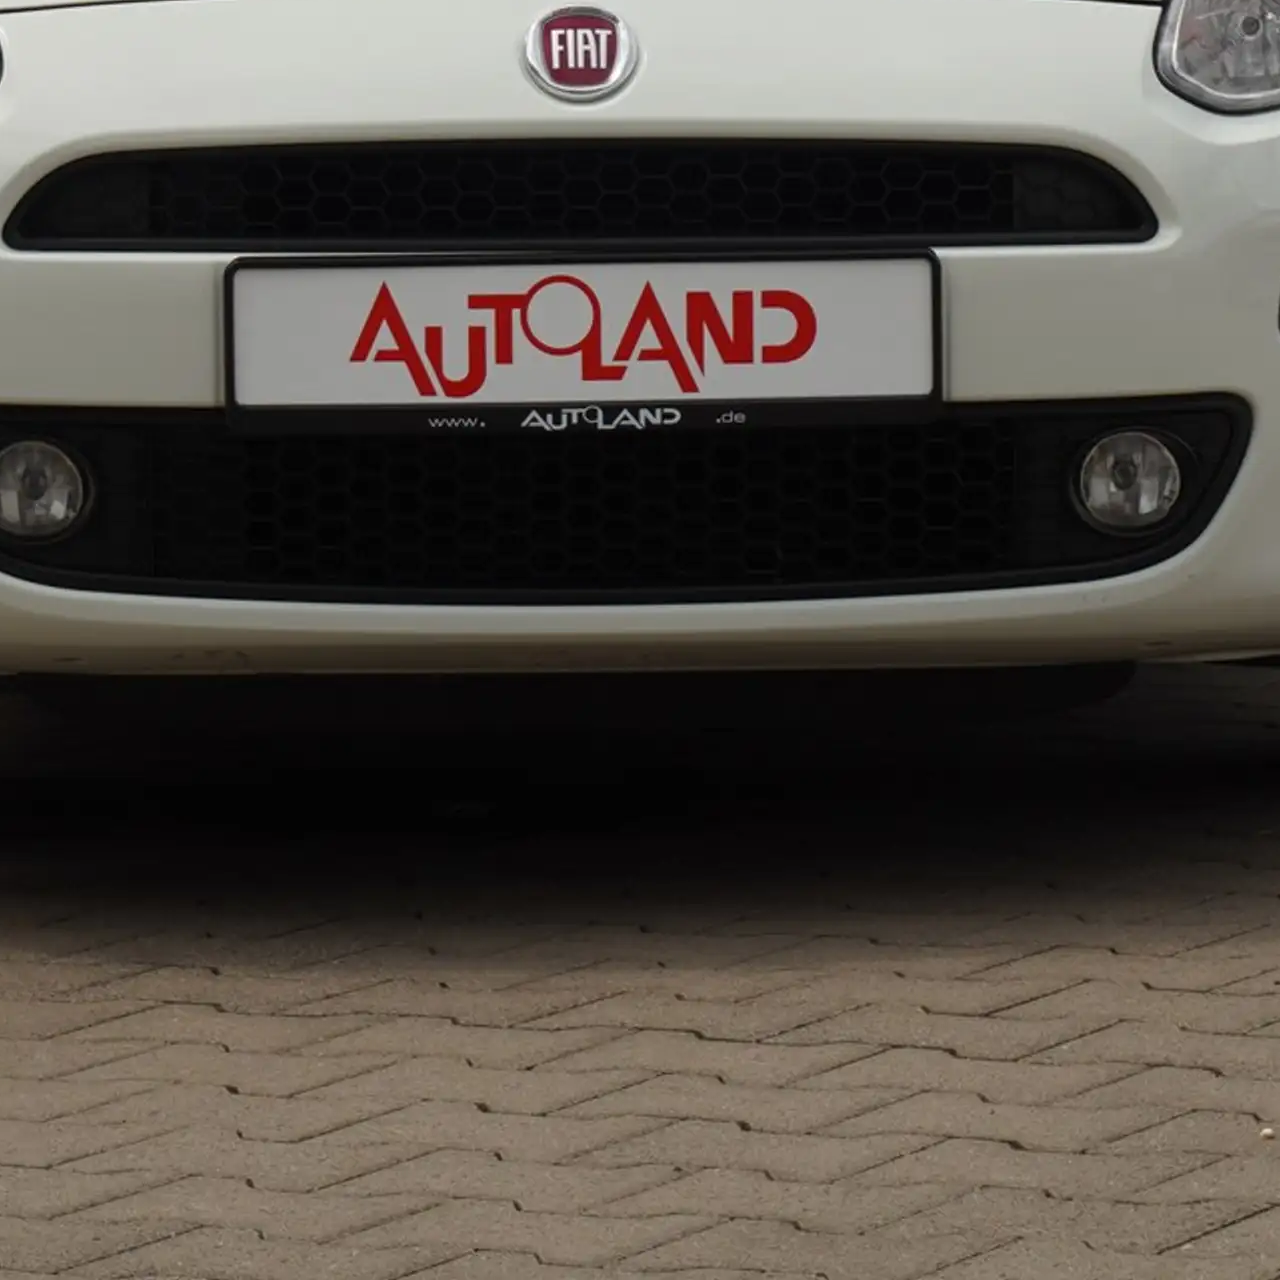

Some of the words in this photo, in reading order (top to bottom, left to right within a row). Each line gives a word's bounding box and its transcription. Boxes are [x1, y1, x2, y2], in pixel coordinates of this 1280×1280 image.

[550, 28, 612, 70] FIAT
[350, 274, 818, 398] AUTOLAND
[428, 415, 486, 429] www.
[521, 404, 682, 431] AUTOLAND
[715, 410, 747, 424] .de
